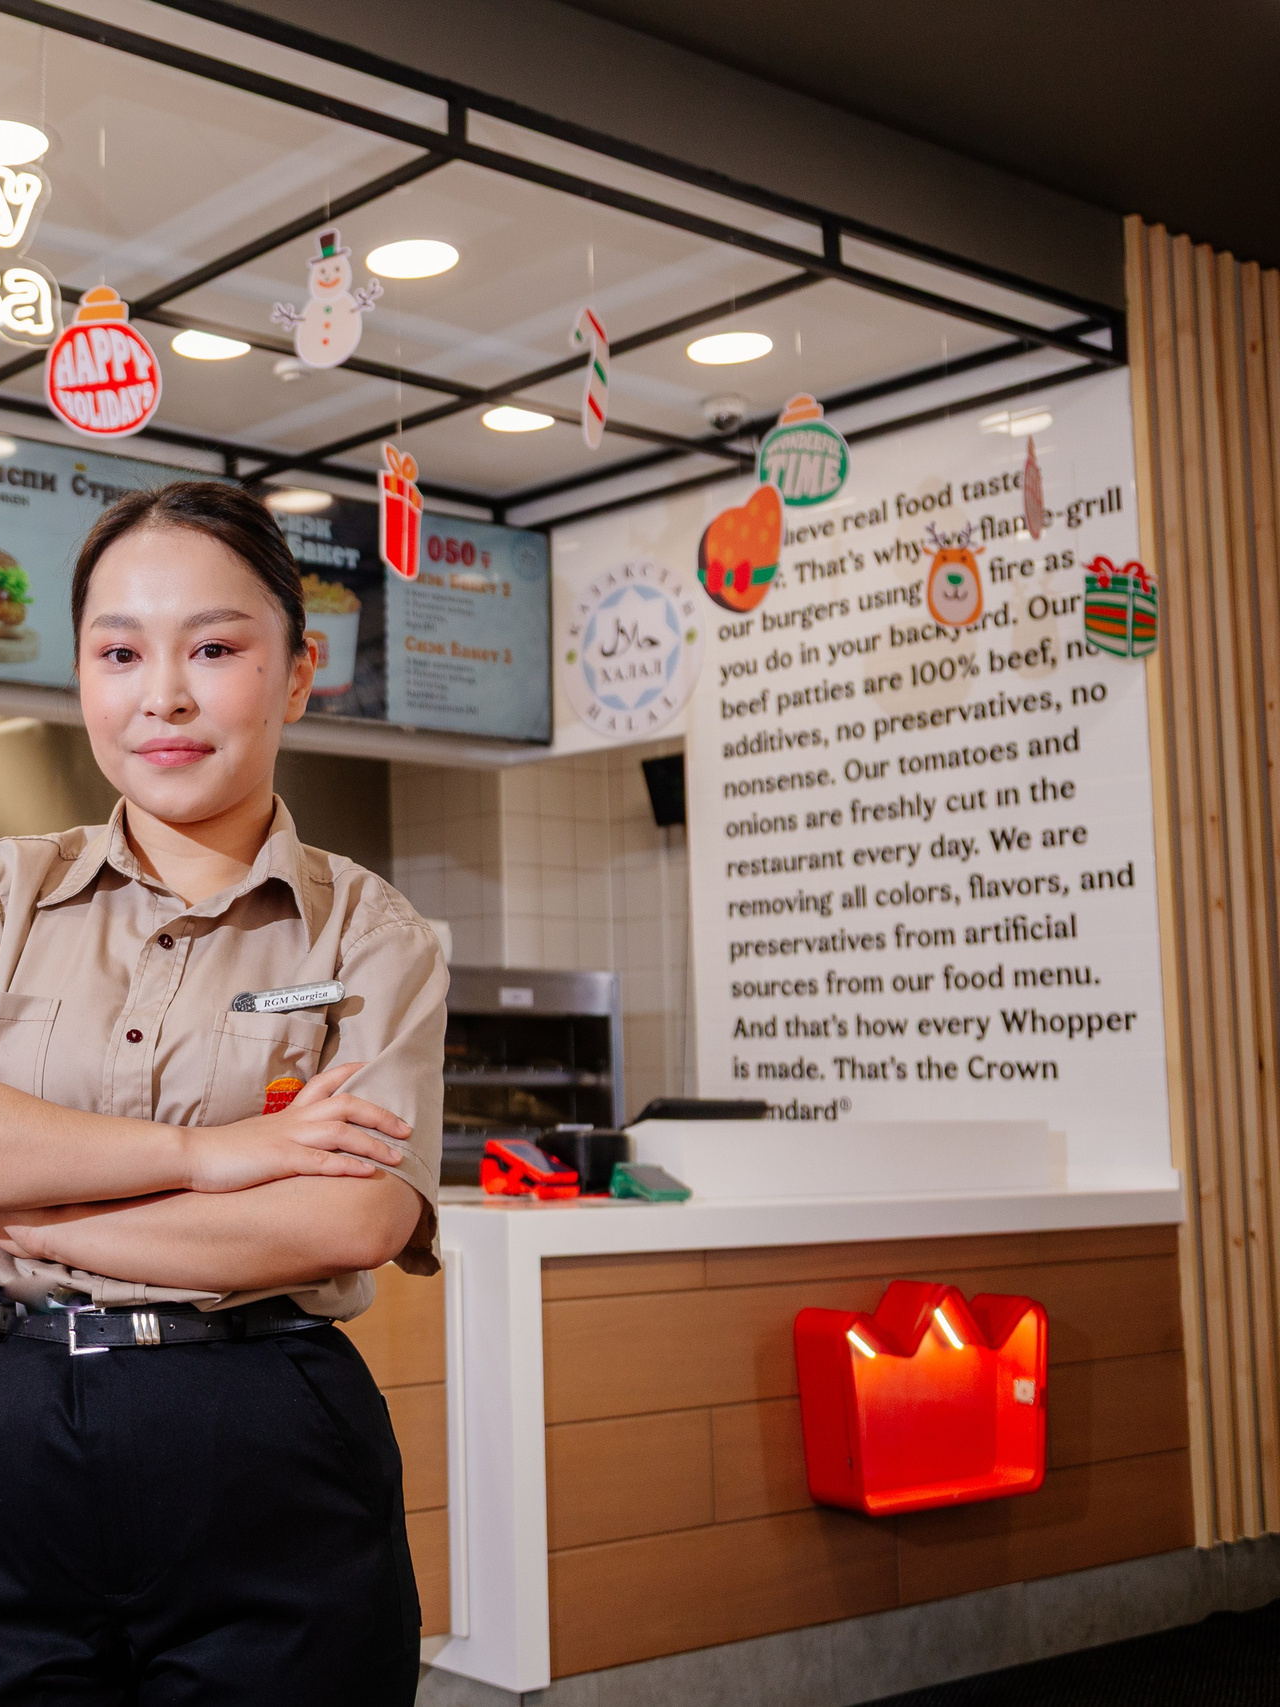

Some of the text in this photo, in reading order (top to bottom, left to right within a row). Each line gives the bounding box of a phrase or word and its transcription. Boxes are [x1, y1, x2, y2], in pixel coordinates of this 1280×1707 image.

[56, 327, 153, 388] HAPPY
[57, 380, 155, 429] HOLIDAYS
[765, 452, 842, 500] TIME
[843, 501, 888, 533] real
[895, 483, 953, 519] food
[426, 534, 477, 568] 050
[794, 550, 865, 585] That's
[873, 538, 925, 566] why
[718, 550, 1076, 642] our burgers using fire as
[720, 658, 758, 686] you
[765, 649, 793, 672] do
[800, 642, 819, 665] in
[827, 632, 881, 666] your
[1028, 595, 1082, 621] Our
[600, 659, 663, 684] ХАЛАЛ
[720, 636, 1101, 720] beef patties are 100% beef, no
[723, 682, 1108, 759] additives, no preservatives, no
[723, 726, 1081, 799] nonsense. Our tomatoes and
[726, 777, 1077, 839] onions are freshly cut in the
[727, 825, 1088, 878] restaurant every day. We are
[728, 862, 1136, 918] removing all colors, flavors, and
[729, 913, 1079, 963] preservatives from artificial
[263, 996, 289, 1008] RGM
[292, 990, 329, 1003] Nargiza
[731, 964, 1101, 999] sources from our food menu.
[733, 1008, 1138, 1040] And that's how every Whopper
[732, 1054, 1060, 1082] is made. That's the Crown
[266, 1091, 297, 1104] BURG
